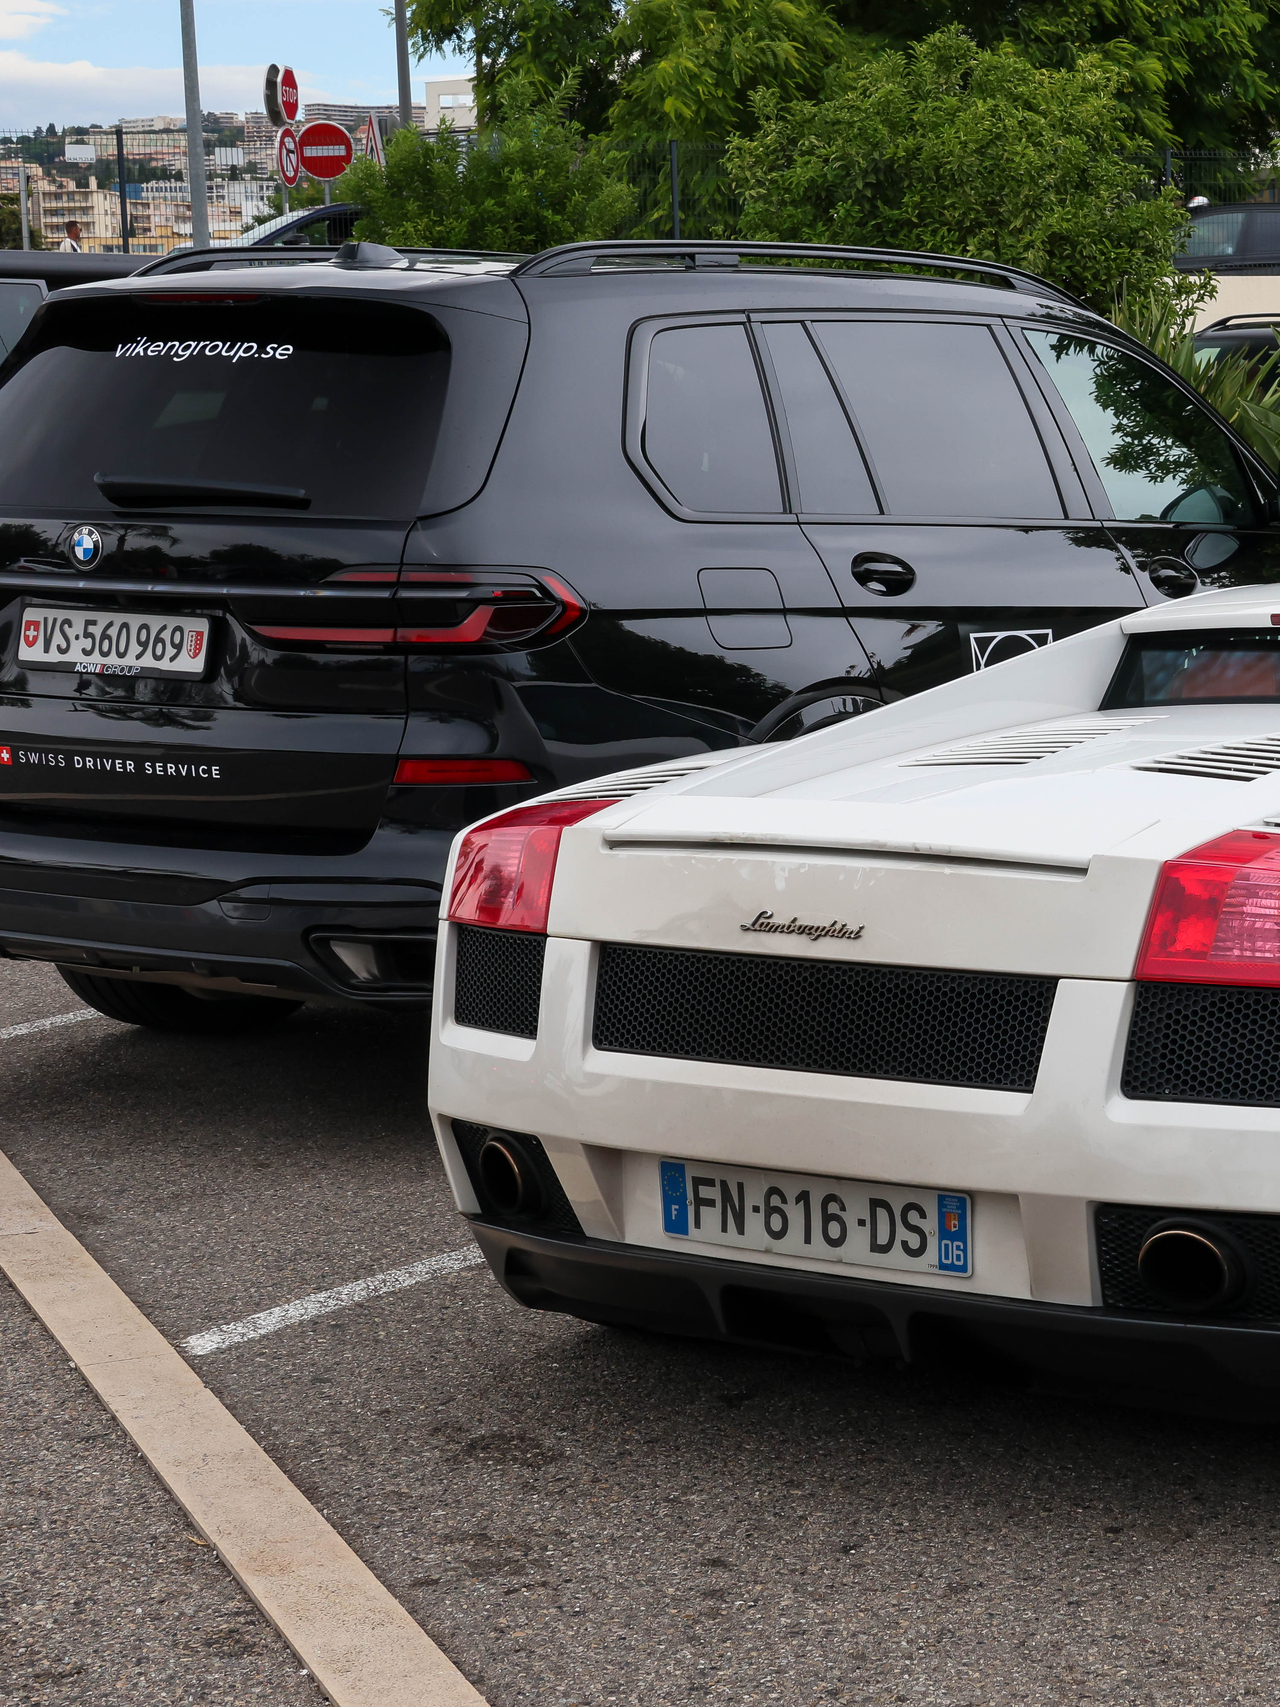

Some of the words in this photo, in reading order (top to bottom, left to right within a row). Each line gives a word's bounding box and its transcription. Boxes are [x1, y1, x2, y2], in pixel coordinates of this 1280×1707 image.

[282, 86, 298, 103] STOP
[115, 336, 294, 363] vikengroup.se
[73, 528, 99, 542] BMW
[103, 664, 141, 676] GROUP
[19, 750, 66, 767] SWISS
[74, 756, 136, 773] DRIVER
[145, 761, 221, 779] SERVICE
[739, 909, 865, 941] Lamborghini
[671, 1205, 679, 1220] F
[691, 1175, 928, 1259] FN-616-DS
[941, 1239, 964, 1266] 06
